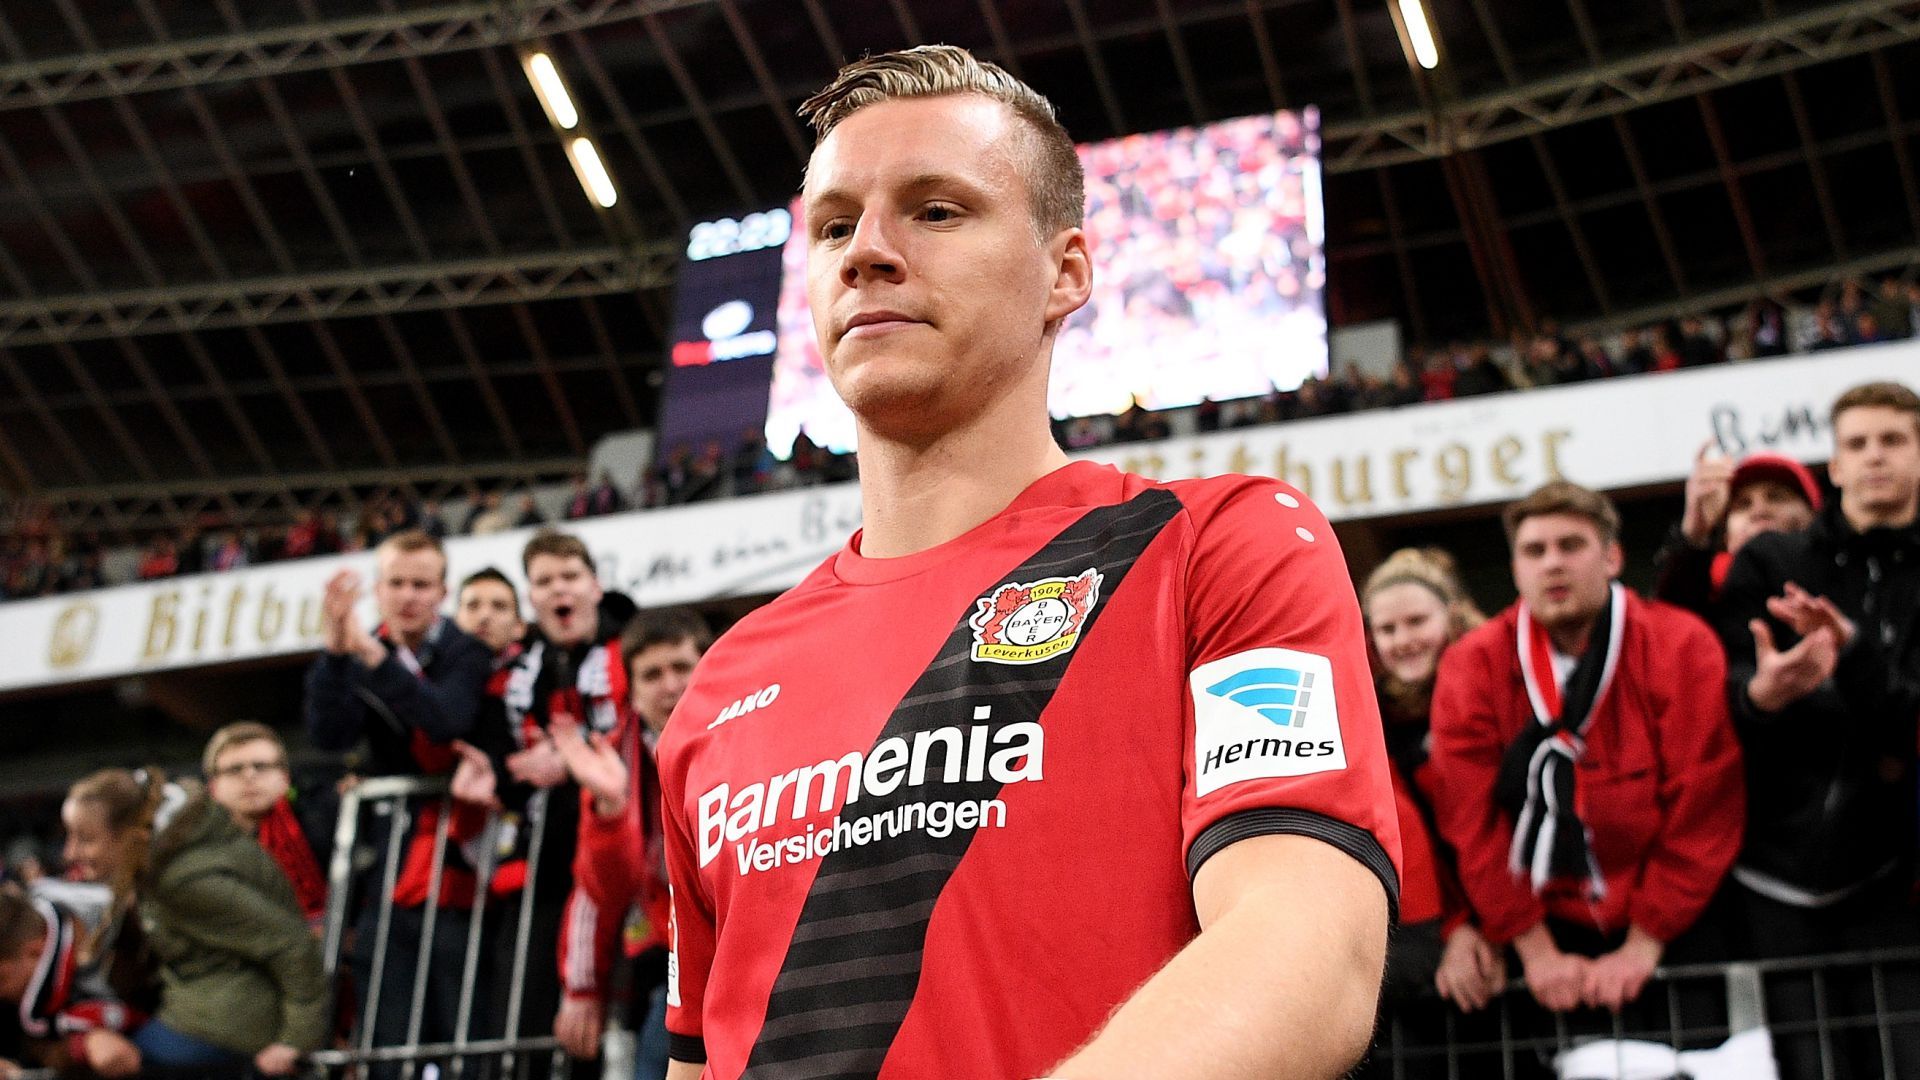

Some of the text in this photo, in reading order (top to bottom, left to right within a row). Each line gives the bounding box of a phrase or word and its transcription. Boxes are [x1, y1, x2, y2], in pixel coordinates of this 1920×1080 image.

[1033, 586, 1061, 598] 1904
[142, 581, 325, 661] Bitbu
[1011, 615, 1063, 628] BAYER
[1026, 601, 1047, 643] BAYER
[985, 639, 1068, 657] Leverkusen
[706, 683, 781, 730] JAKO
[1203, 738, 1334, 775] Hermes
[698, 705, 1044, 869] Barmenia
[736, 799, 1007, 876] Versicherungen
